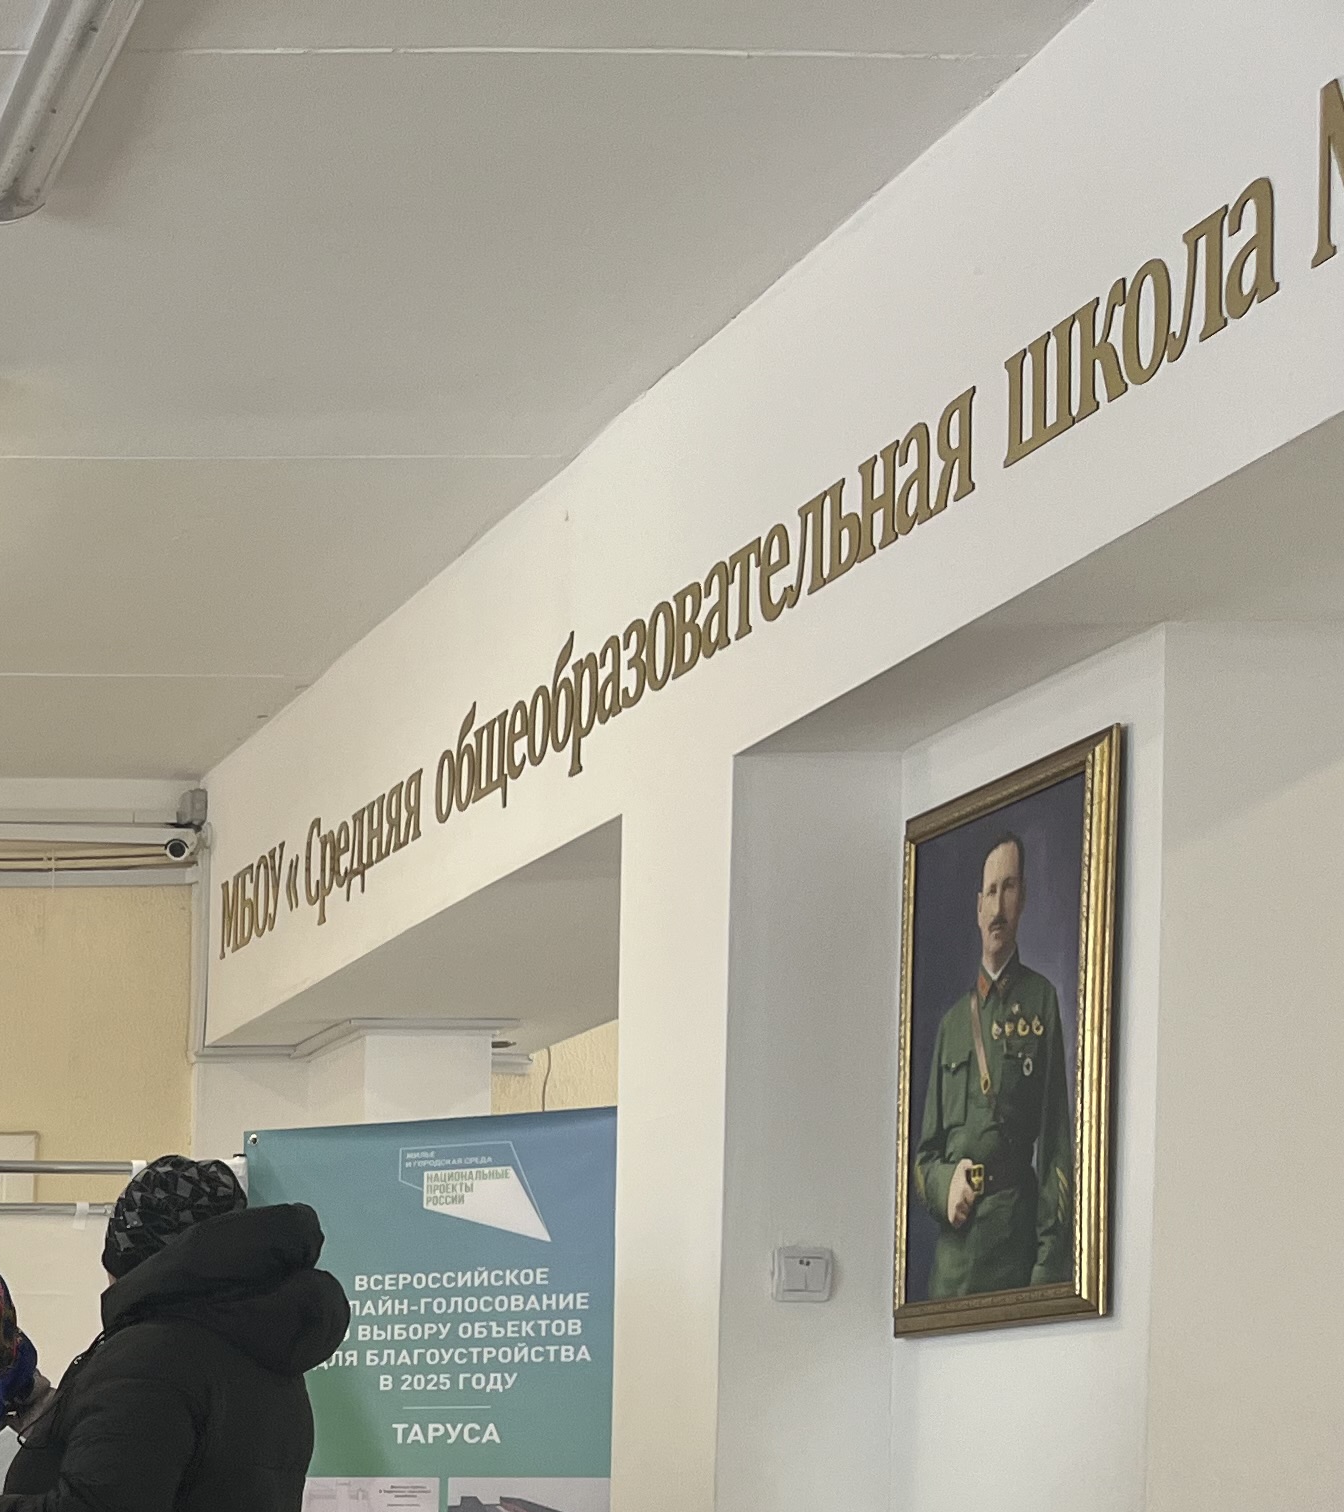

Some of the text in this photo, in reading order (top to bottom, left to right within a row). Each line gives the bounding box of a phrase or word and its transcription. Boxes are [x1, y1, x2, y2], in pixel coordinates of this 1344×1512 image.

[219, 841, 285, 960] МБОУ
[305, 768, 421, 925] Средняя
[436, 386, 977, 826] общеобразовательная
[1004, 176, 1280, 468] школа
[426, 1168, 511, 1183] НАЦИОНАЛЬНЫЕ
[426, 1182, 474, 1194] ПРОЕКТЫ
[426, 1194, 465, 1206] РОССИИ
[354, 1266, 549, 1292] ВСЕРОССИЙСКОЕ
[350, 1292, 590, 1317] ЛАЙН-ГОЛОСОВАНИЕ
[357, 1322, 451, 1342] ВЫБОРУ
[458, 1319, 582, 1340] ОБЪЕКТОВ
[365, 1343, 592, 1367] БЛАГОУСТРОЙСТВА
[379, 1372, 519, 1393] В 2025 ГОДУ
[392, 1422, 501, 1445] ТАРУСА
